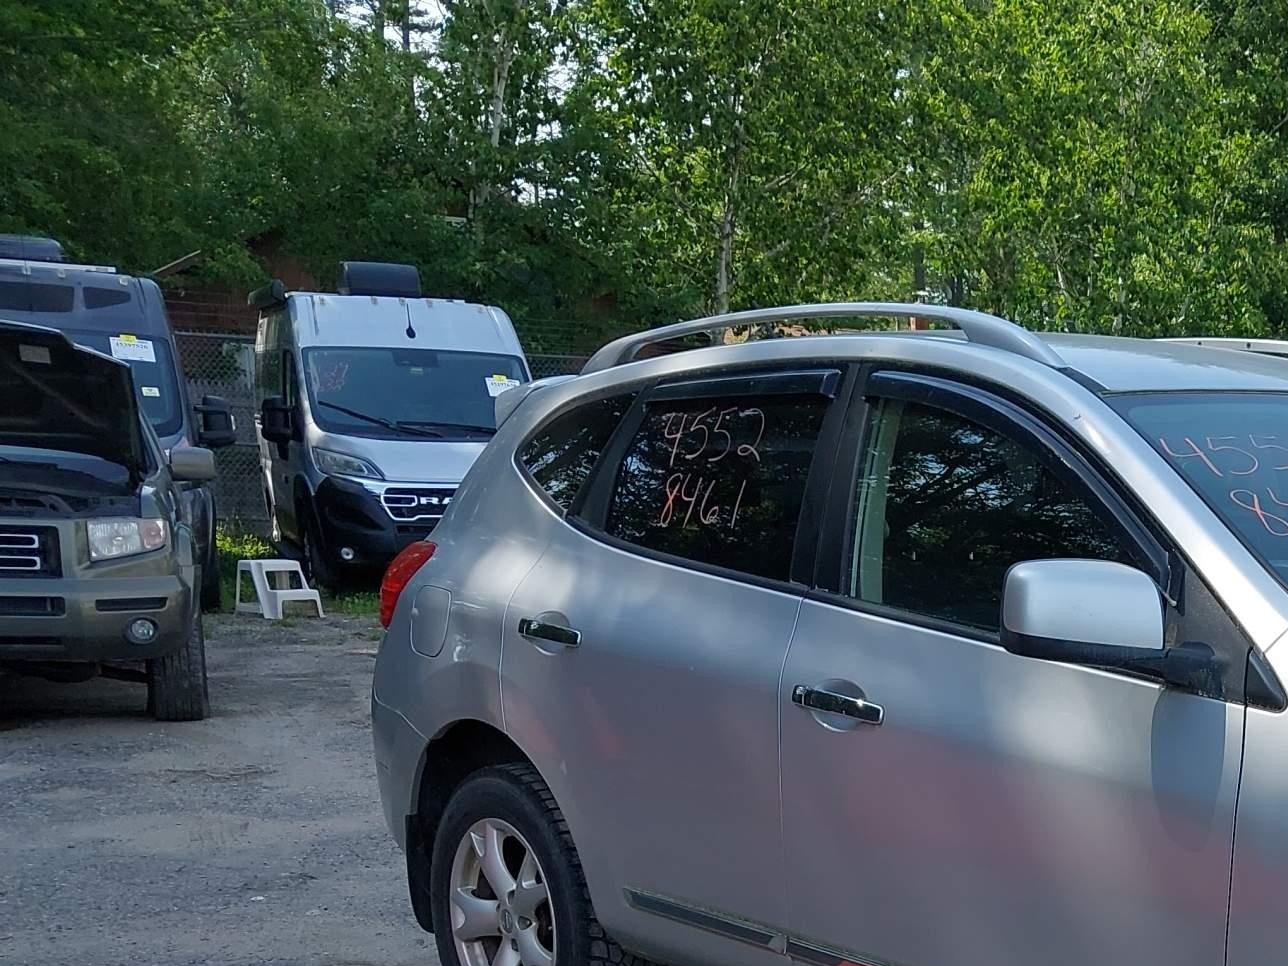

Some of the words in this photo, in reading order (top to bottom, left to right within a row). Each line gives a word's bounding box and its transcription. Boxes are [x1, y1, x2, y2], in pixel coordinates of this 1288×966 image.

[664, 406, 765, 467] 4552
[420, 496, 454, 505] RA
[659, 472, 747, 529] 8461
